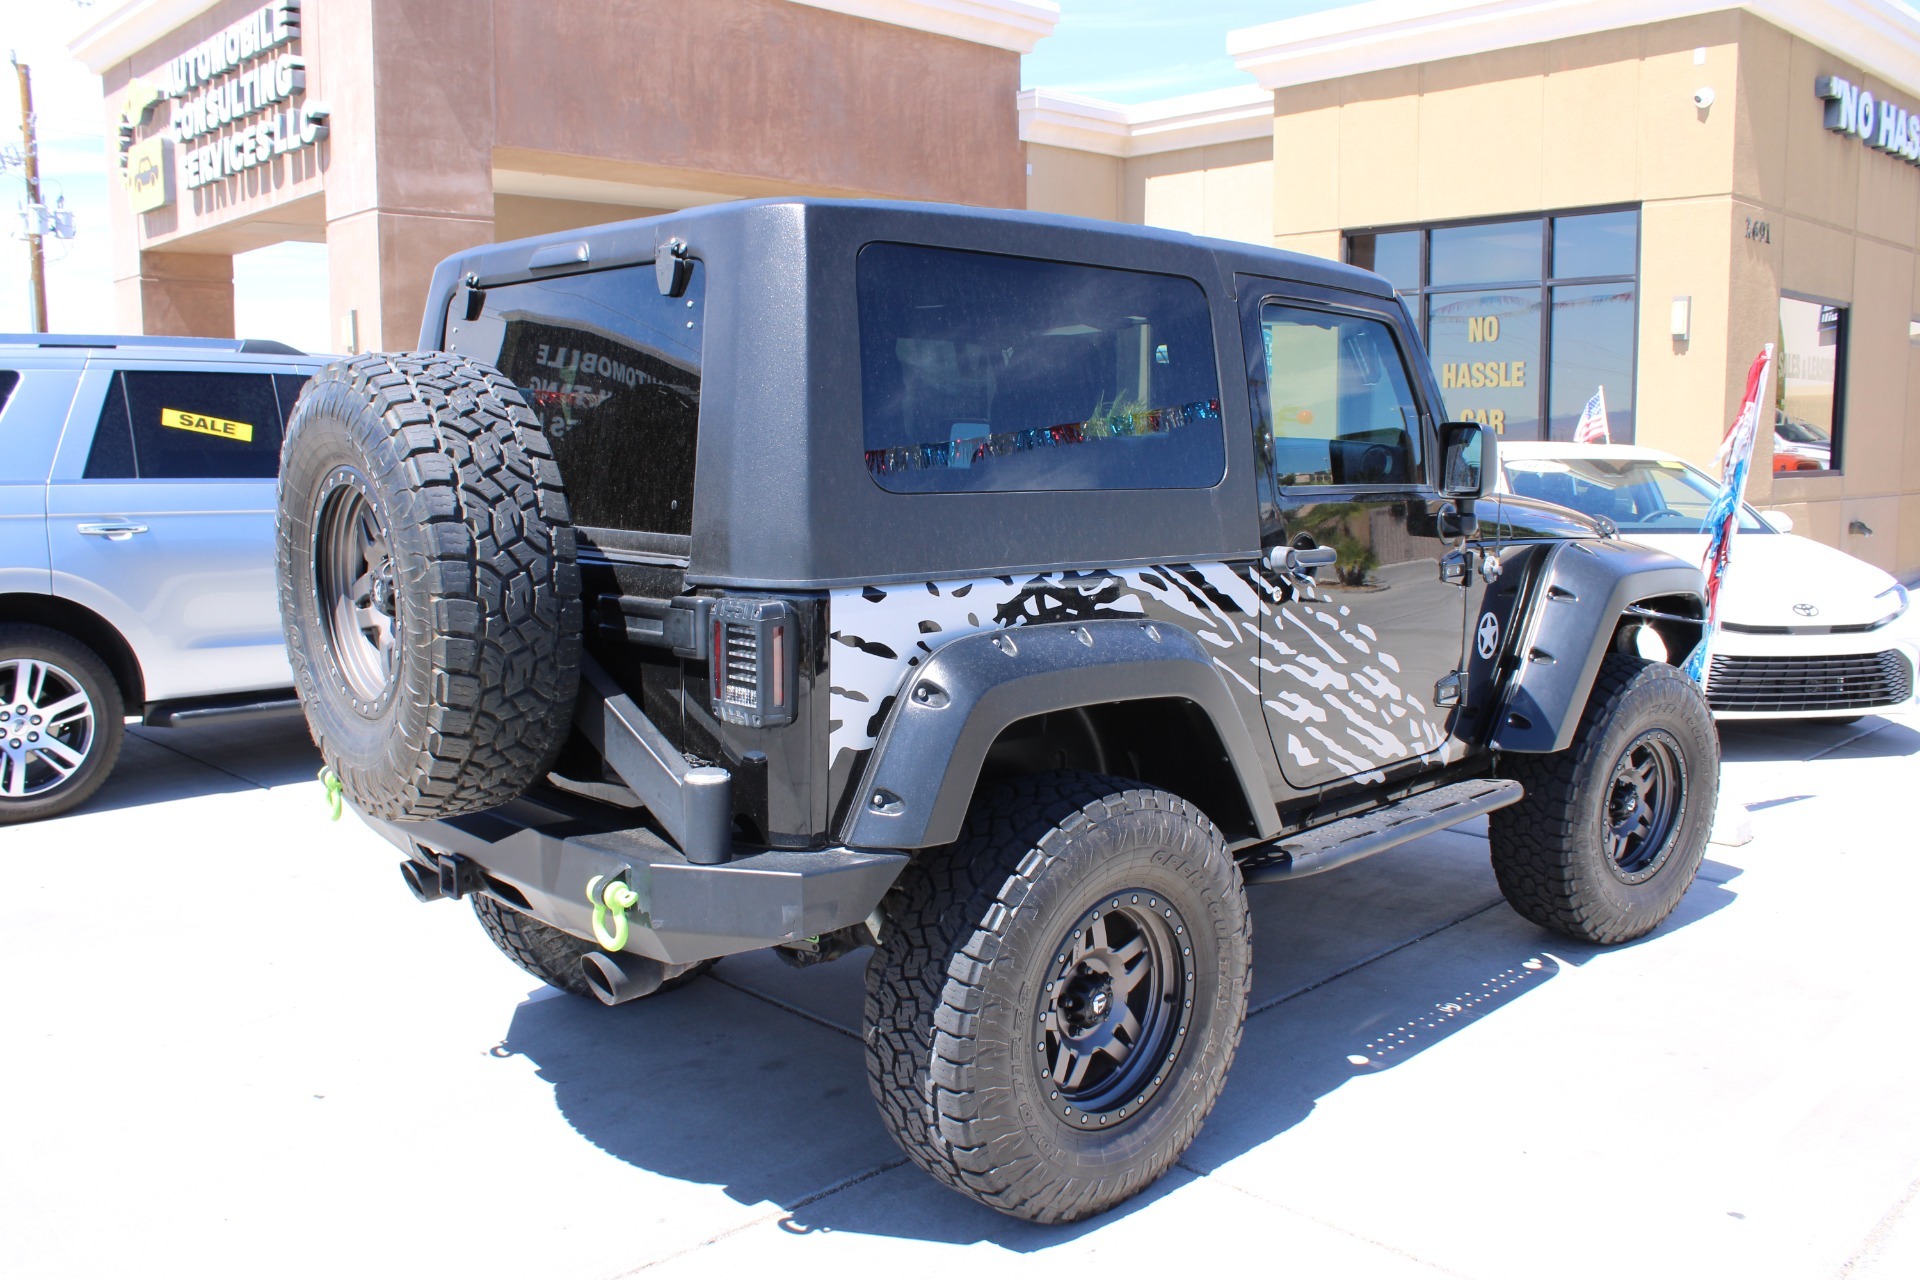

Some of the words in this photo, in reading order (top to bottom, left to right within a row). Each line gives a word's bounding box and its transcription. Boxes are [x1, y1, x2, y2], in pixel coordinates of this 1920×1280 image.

[163, 0, 300, 100] AUTOMOBILE
[170, 54, 305, 143] CONSULTING
[1879, 100, 1920, 161] HAS
[1468, 316, 1499, 343] NO
[1442, 361, 1526, 388] HASSLE
[179, 413, 236, 435] SALE
